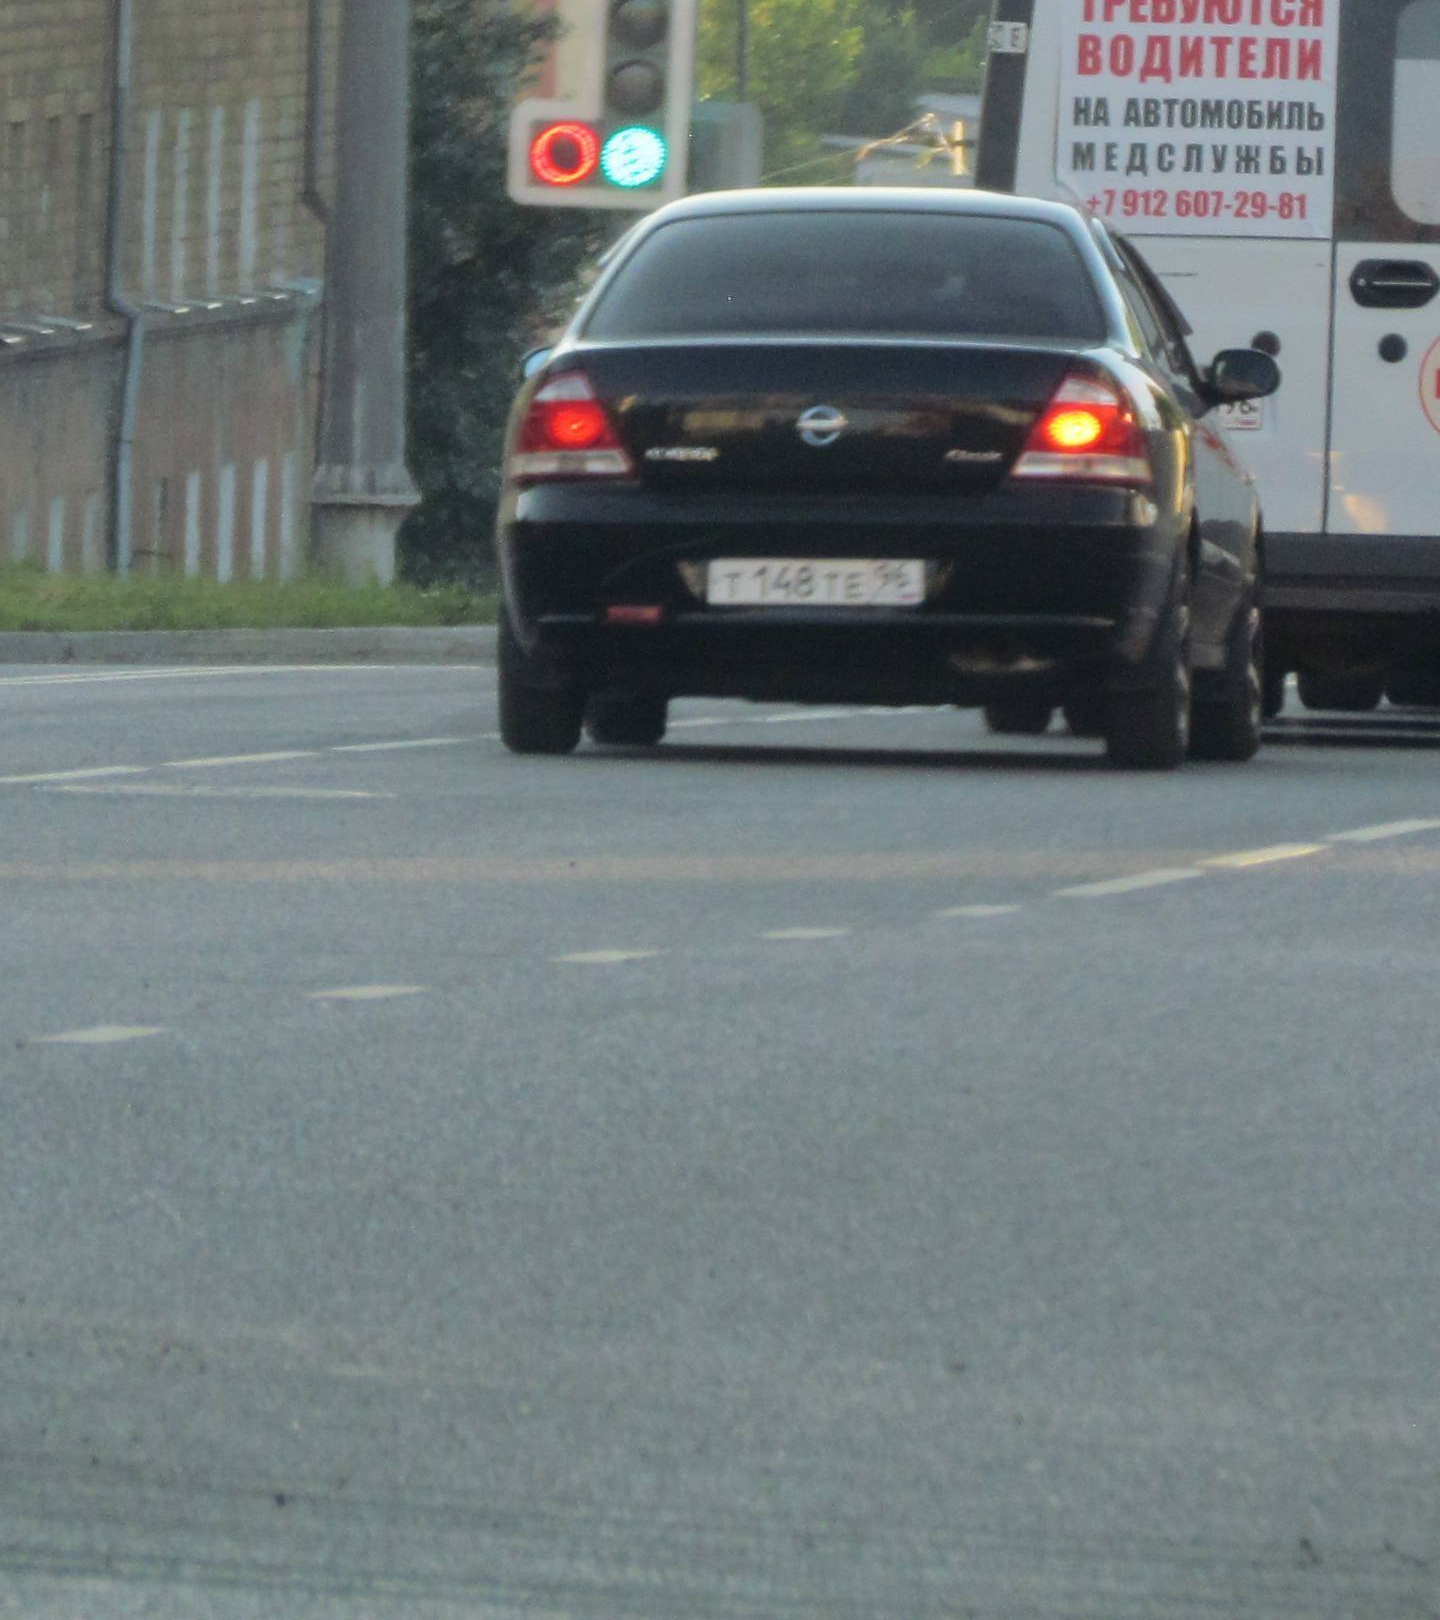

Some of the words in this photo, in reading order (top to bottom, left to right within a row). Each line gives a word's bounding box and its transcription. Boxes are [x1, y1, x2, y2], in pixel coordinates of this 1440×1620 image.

[1077, 34, 1323, 83] ВОДИТЕЛИ
[1073, 97, 1109, 126] НА
[1123, 98, 1325, 131] АВТОМОБИЛЬ
[1072, 142, 1325, 177] МЕДСЛУЖБЫ
[1086, 189, 1117, 216] +7
[1122, 190, 1168, 217] 912
[1175, 191, 1308, 220] 607-29-81
